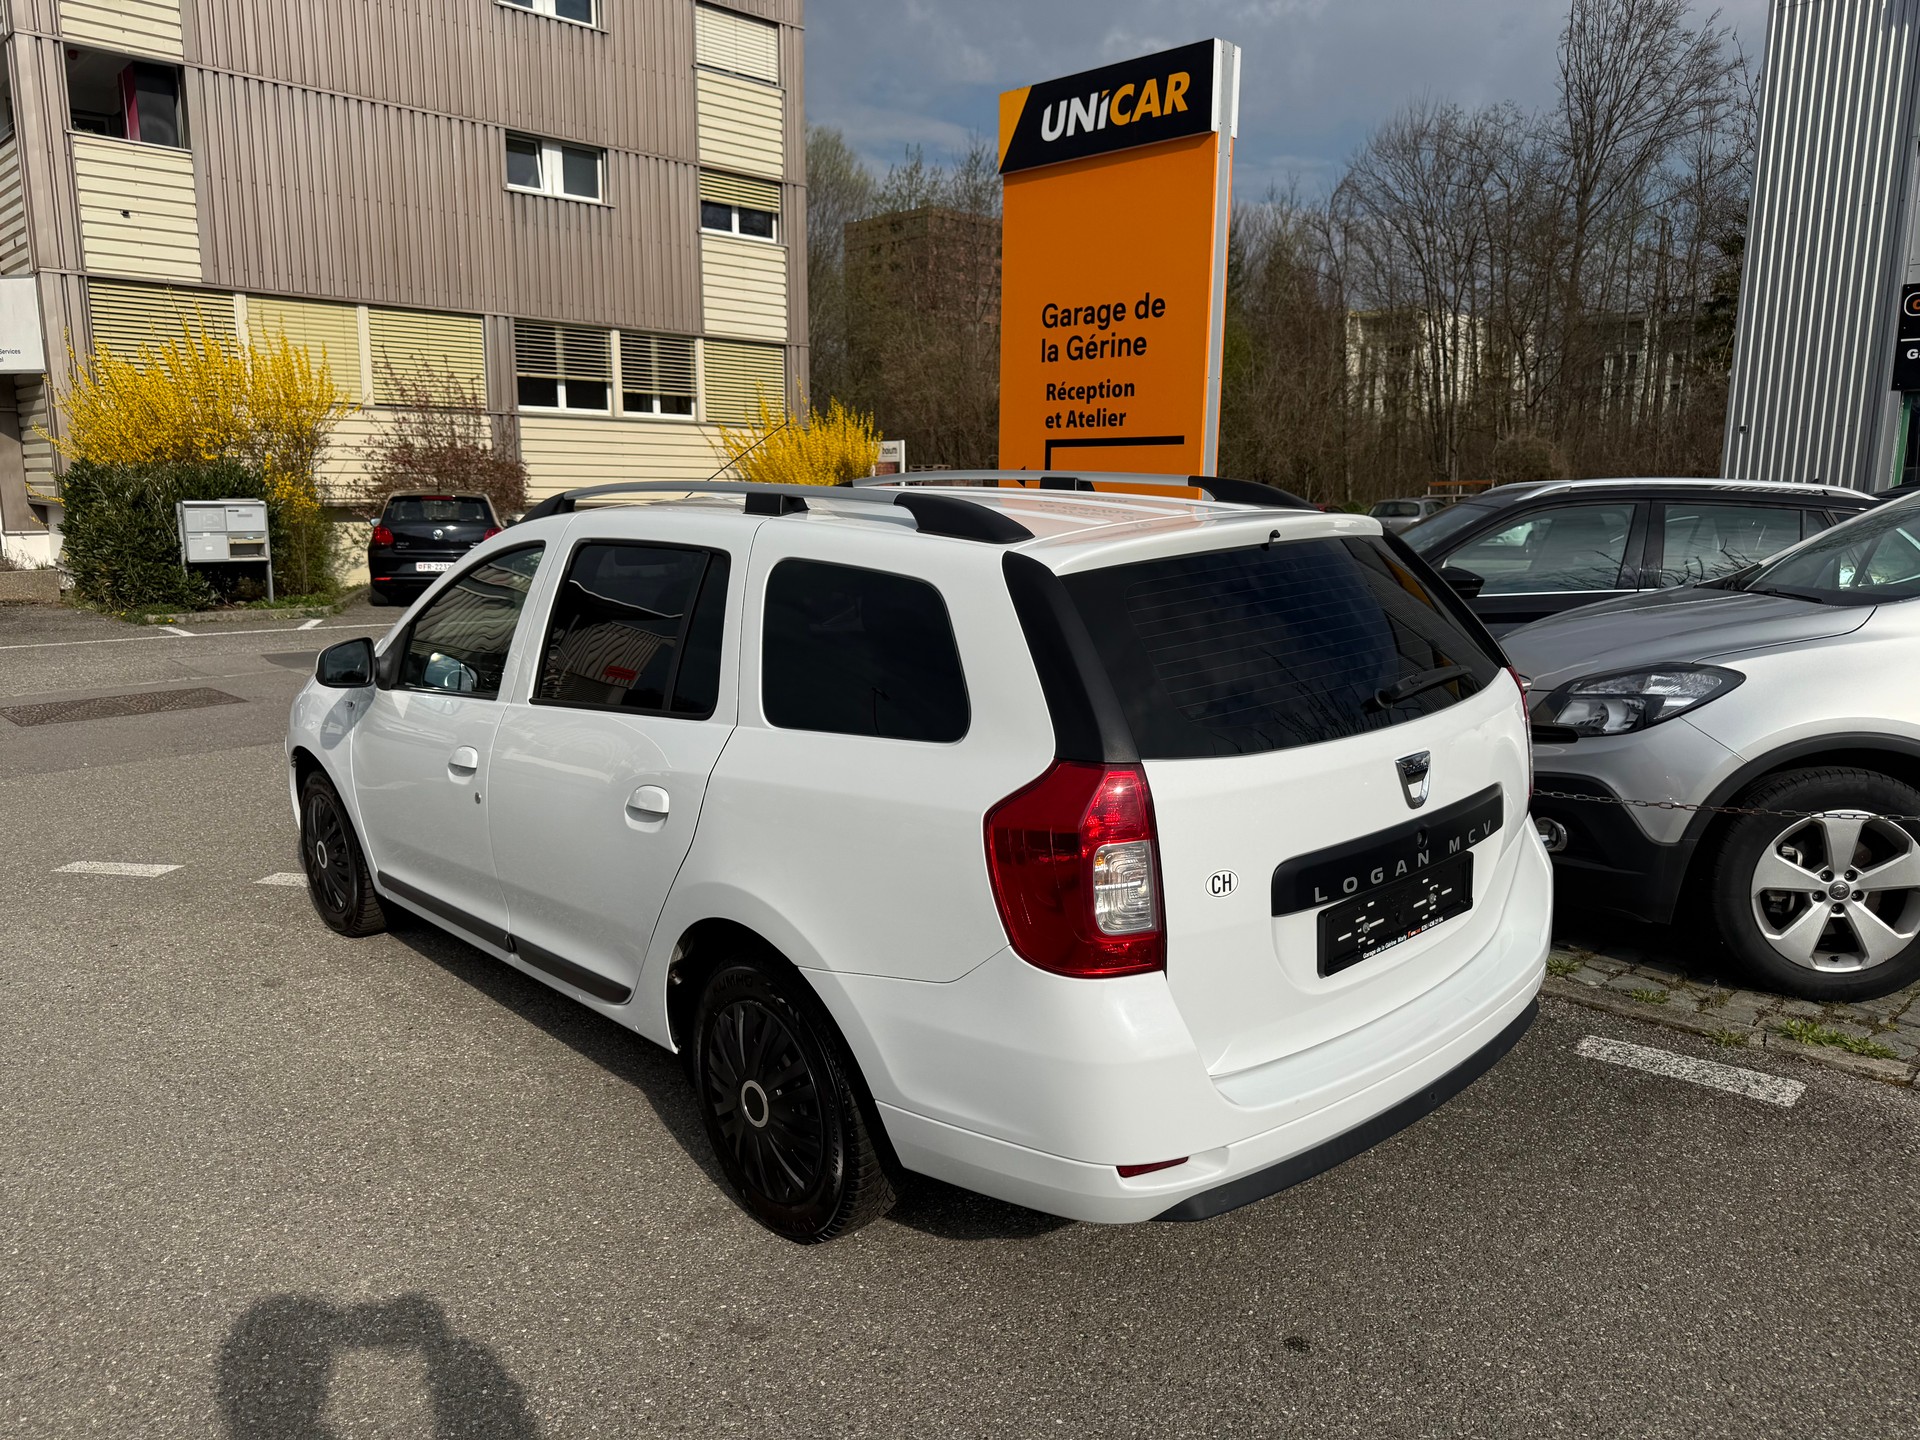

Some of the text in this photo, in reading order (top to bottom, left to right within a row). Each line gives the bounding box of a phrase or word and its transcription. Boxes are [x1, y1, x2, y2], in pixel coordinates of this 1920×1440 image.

[1042, 292, 1166, 330] Garage de
[1041, 332, 1147, 362] la Gérine
[1046, 379, 1135, 404] Réception
[1045, 408, 1126, 428] et Atelier
[1314, 820, 1491, 902] LOGAN MCV
[1211, 873, 1232, 894] CH
